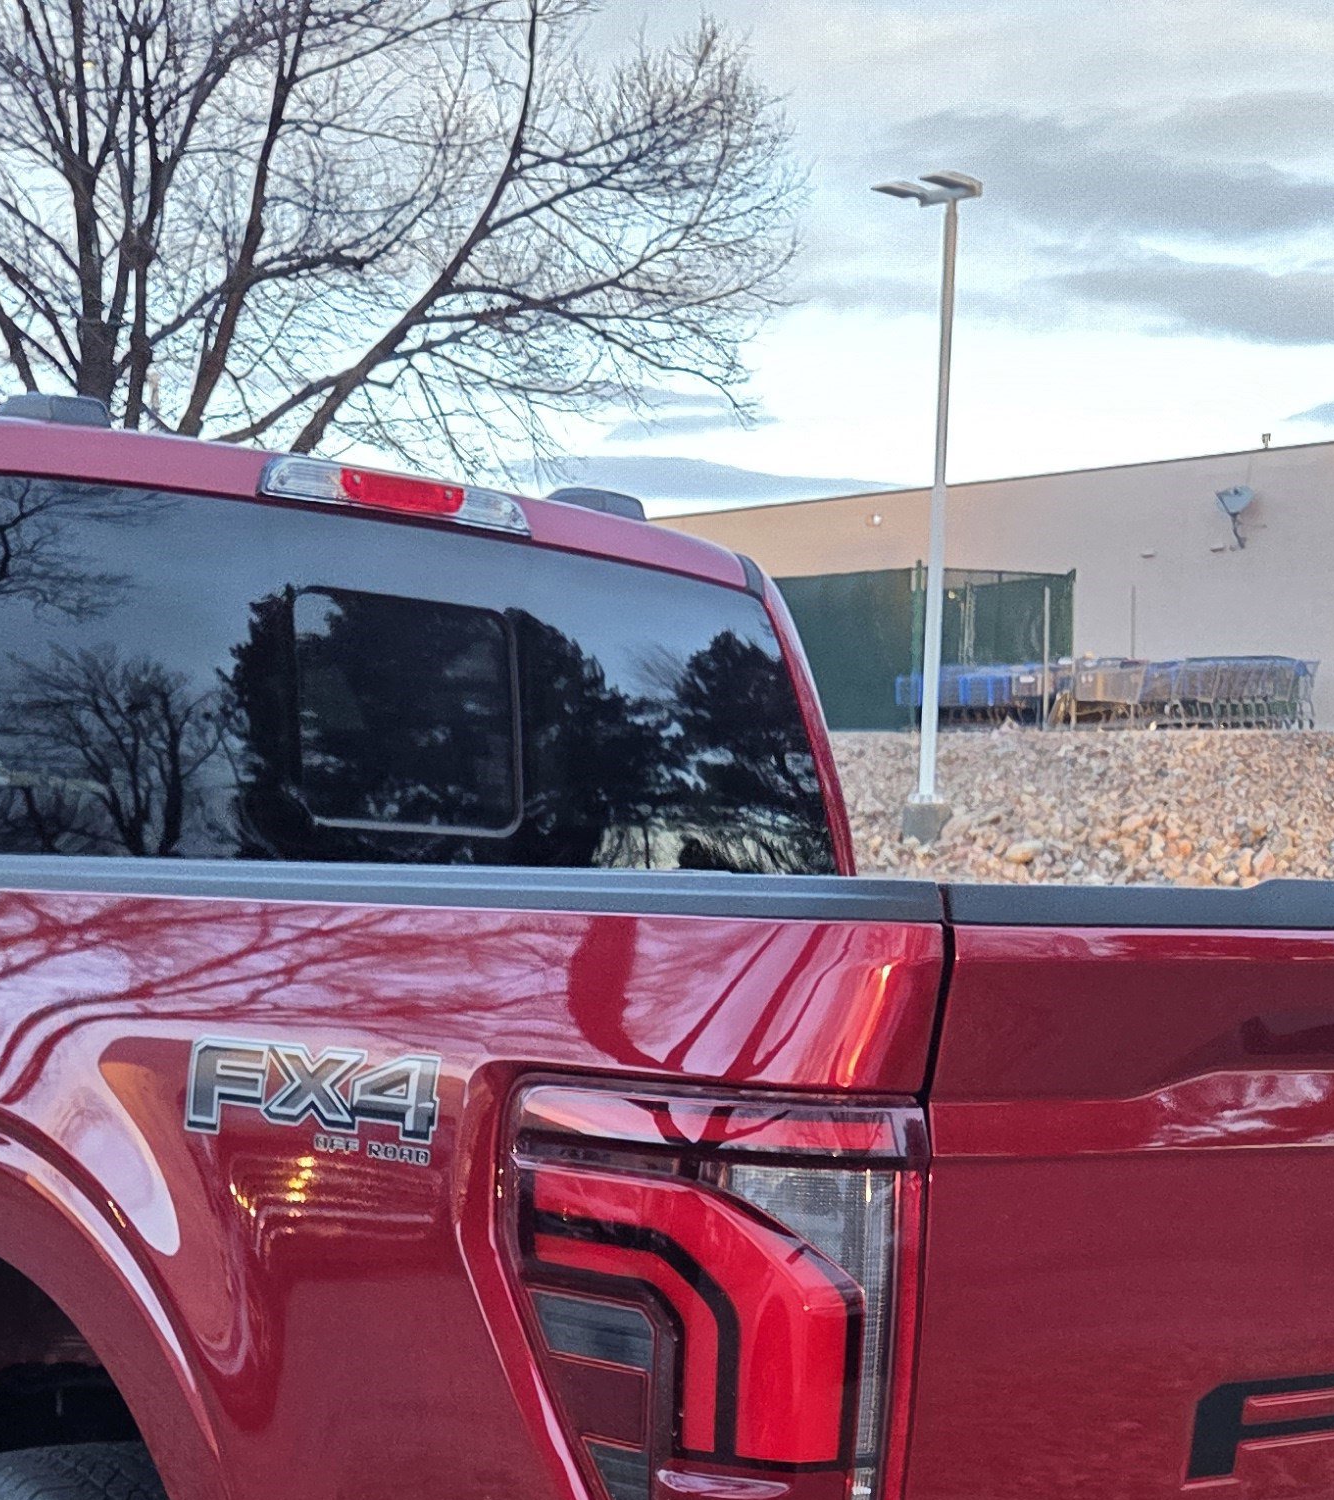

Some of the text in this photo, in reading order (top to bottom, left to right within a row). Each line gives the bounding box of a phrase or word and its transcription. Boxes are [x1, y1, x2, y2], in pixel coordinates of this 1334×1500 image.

[184, 1034, 441, 1144] FX4
[314, 1134, 430, 1165] OFF ROAD
